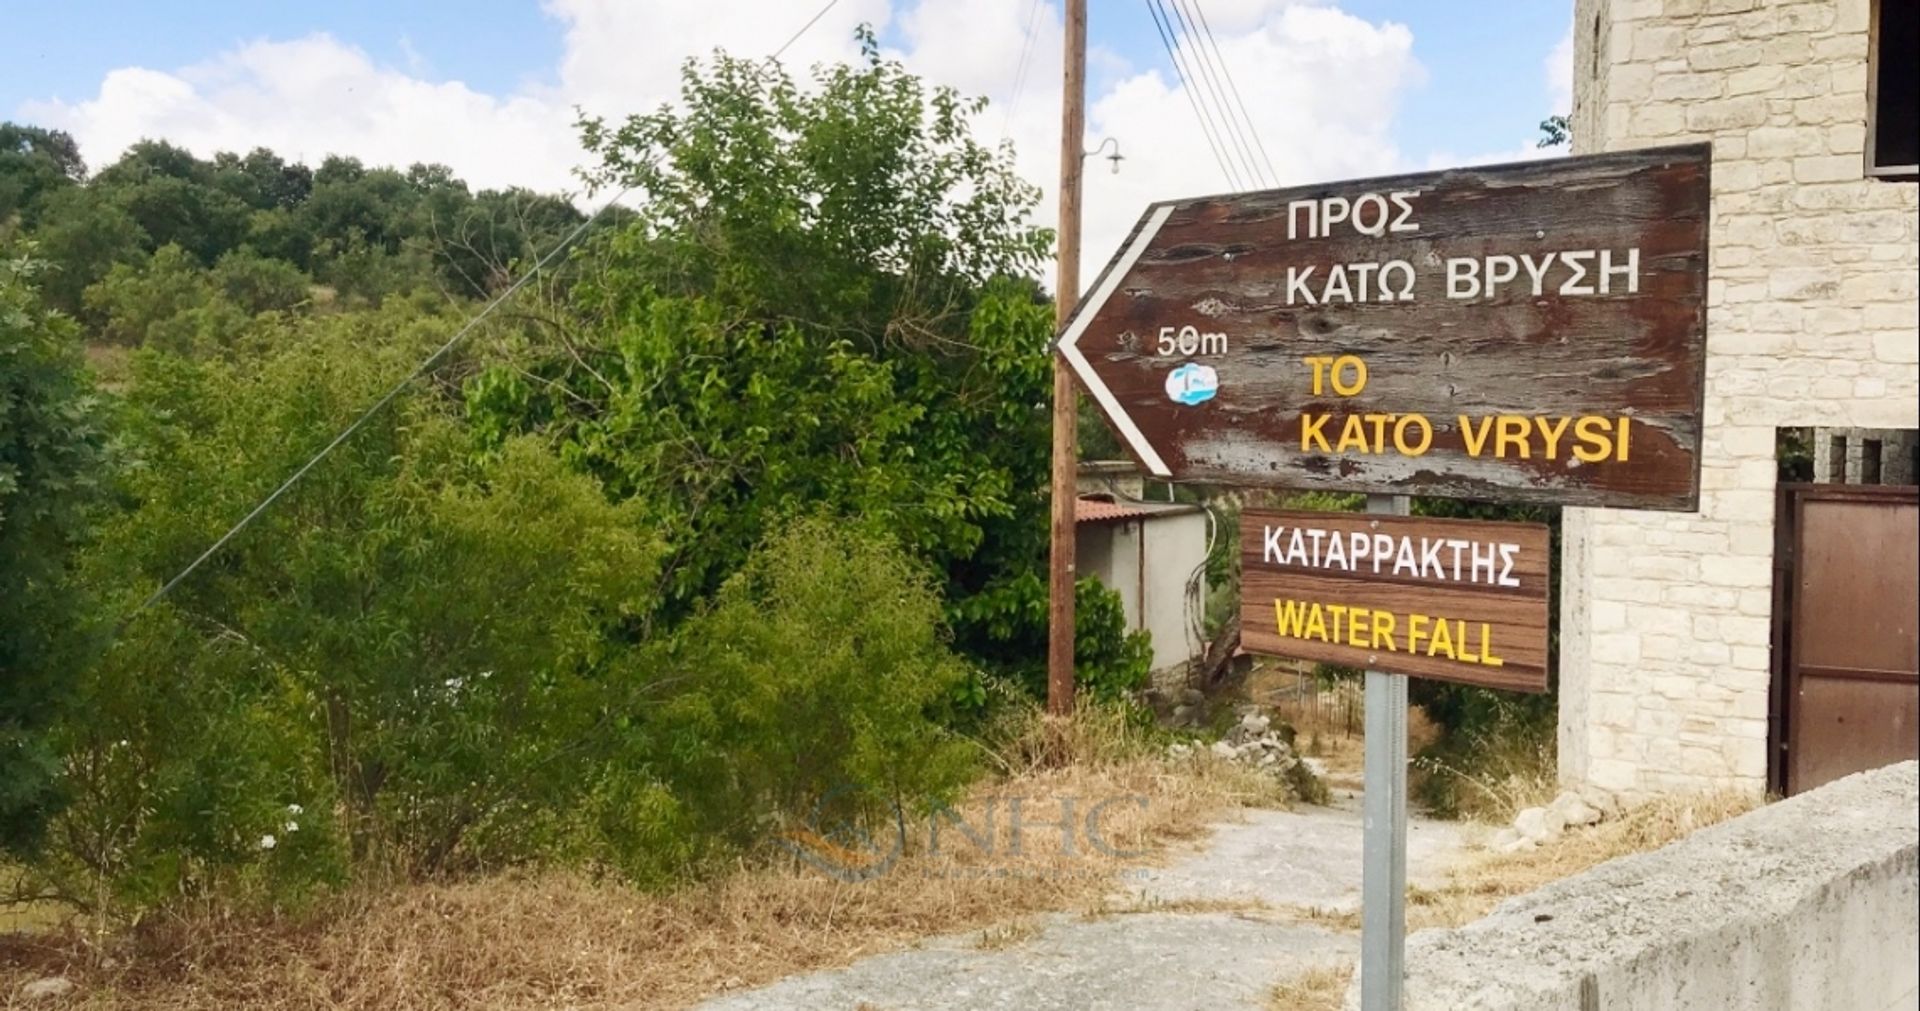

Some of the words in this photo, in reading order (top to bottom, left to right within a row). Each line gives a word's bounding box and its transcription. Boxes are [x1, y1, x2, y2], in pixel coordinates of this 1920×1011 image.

[1287, 190, 1421, 240] ΠΡΟΣ
[1287, 258, 1416, 305] ΚΑΤΩ
[1446, 248, 1640, 300] ΒΡΥΣΗ
[1157, 325, 1228, 356] 50m
[1304, 355, 1367, 396] TO
[1301, 413, 1433, 457] KATO
[1459, 415, 1631, 462] VRYSI
[1264, 525, 1521, 588] ΚΑΤΑΡΡΑΚΤΗΣ
[1275, 598, 1396, 651] WATER
[1409, 614, 1503, 667] FALL
